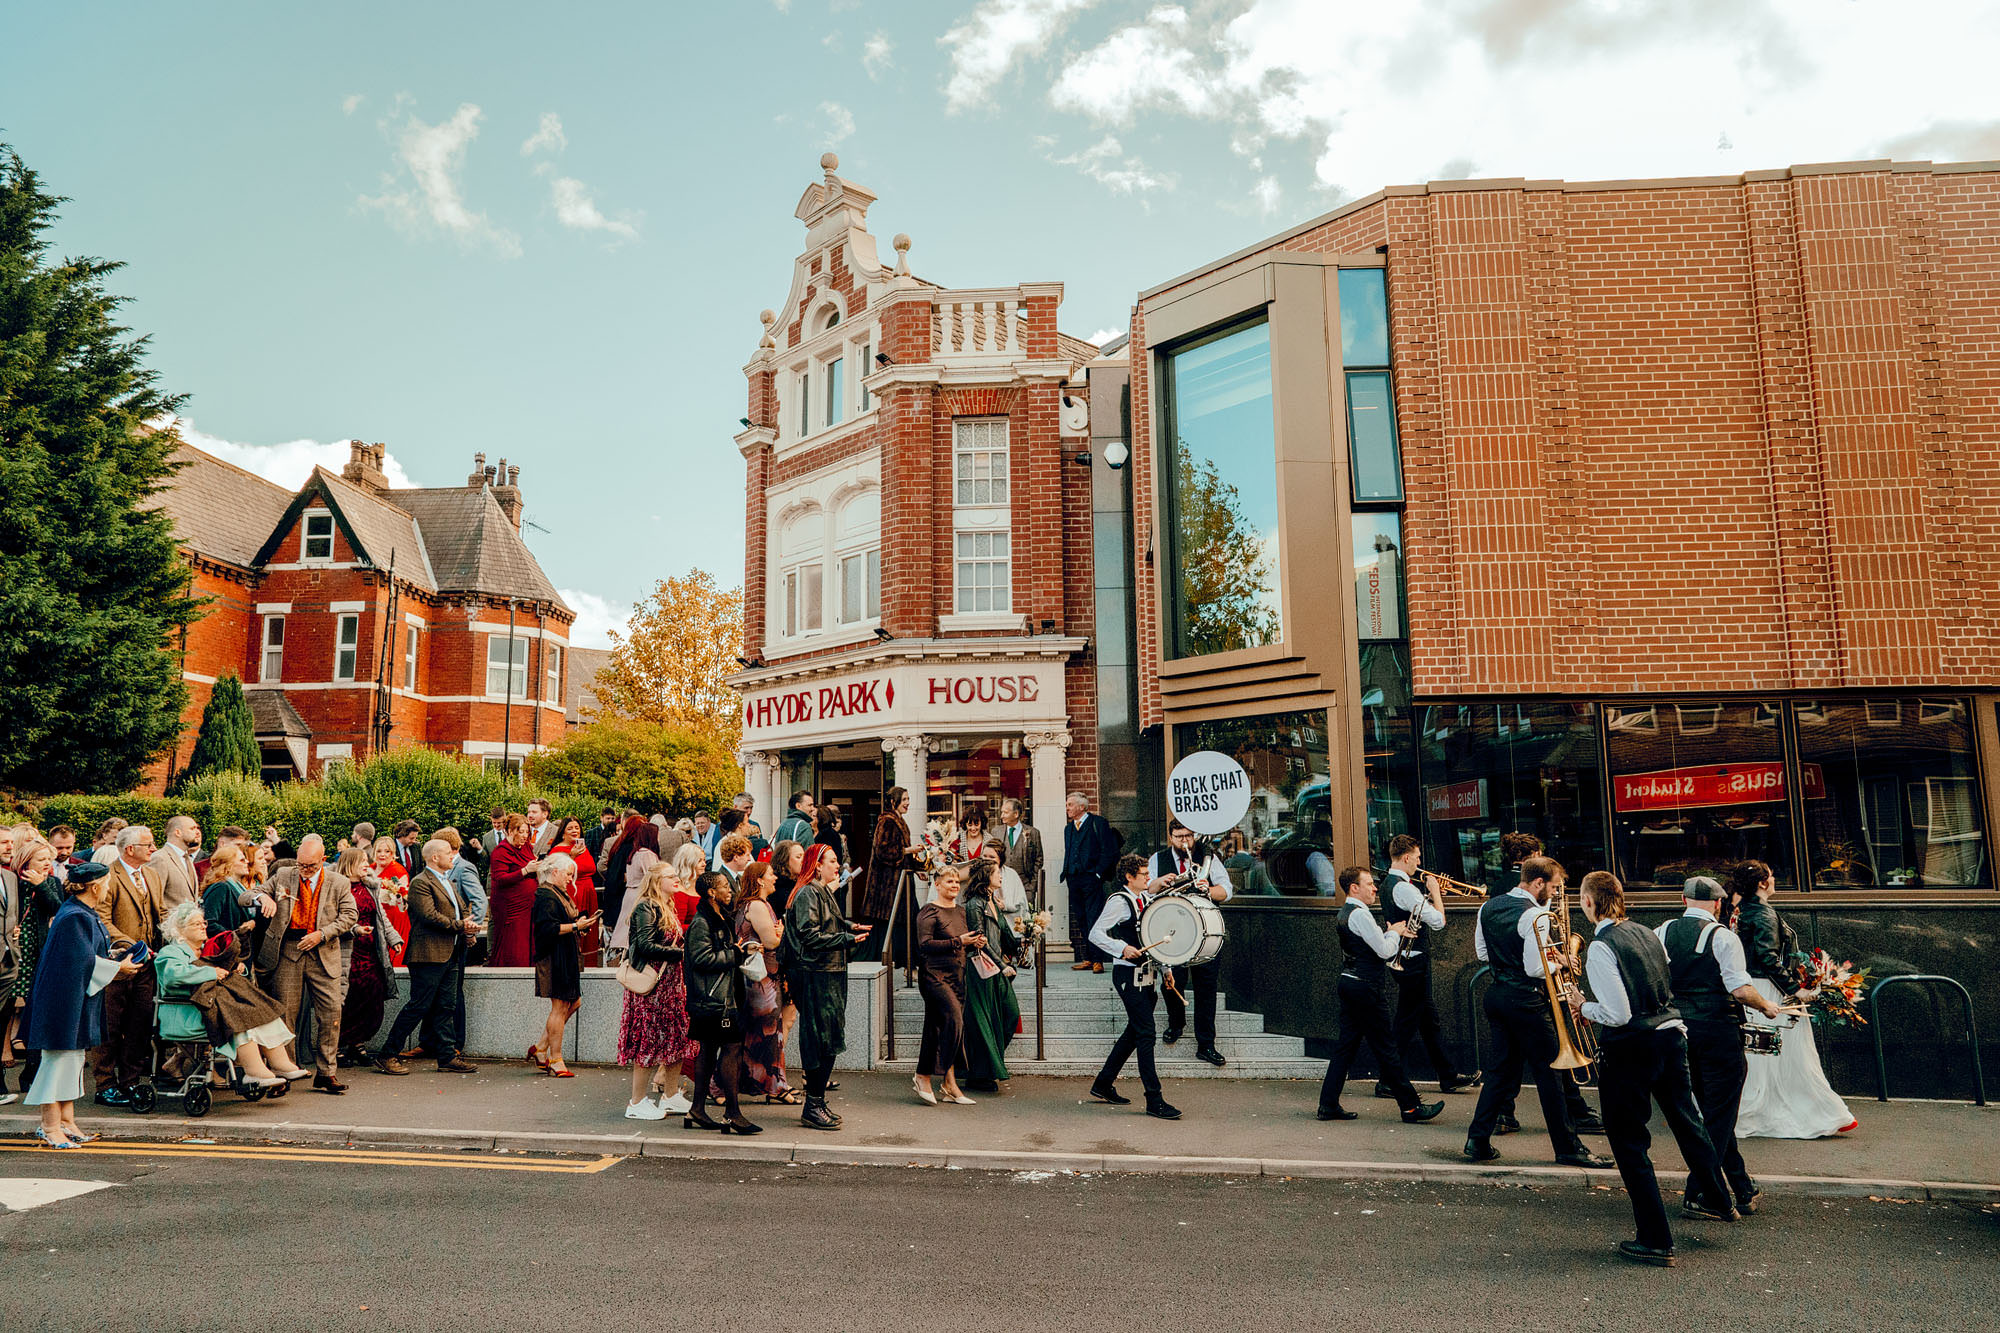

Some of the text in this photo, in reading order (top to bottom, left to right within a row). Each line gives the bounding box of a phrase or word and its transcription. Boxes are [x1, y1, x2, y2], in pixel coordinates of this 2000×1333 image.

[928, 675, 1039, 704] HOUSE
[757, 679, 882, 727] HYDE PARK
[1173, 770, 1242, 794] BACK CHAT
[1175, 793, 1218, 812] BRASS
